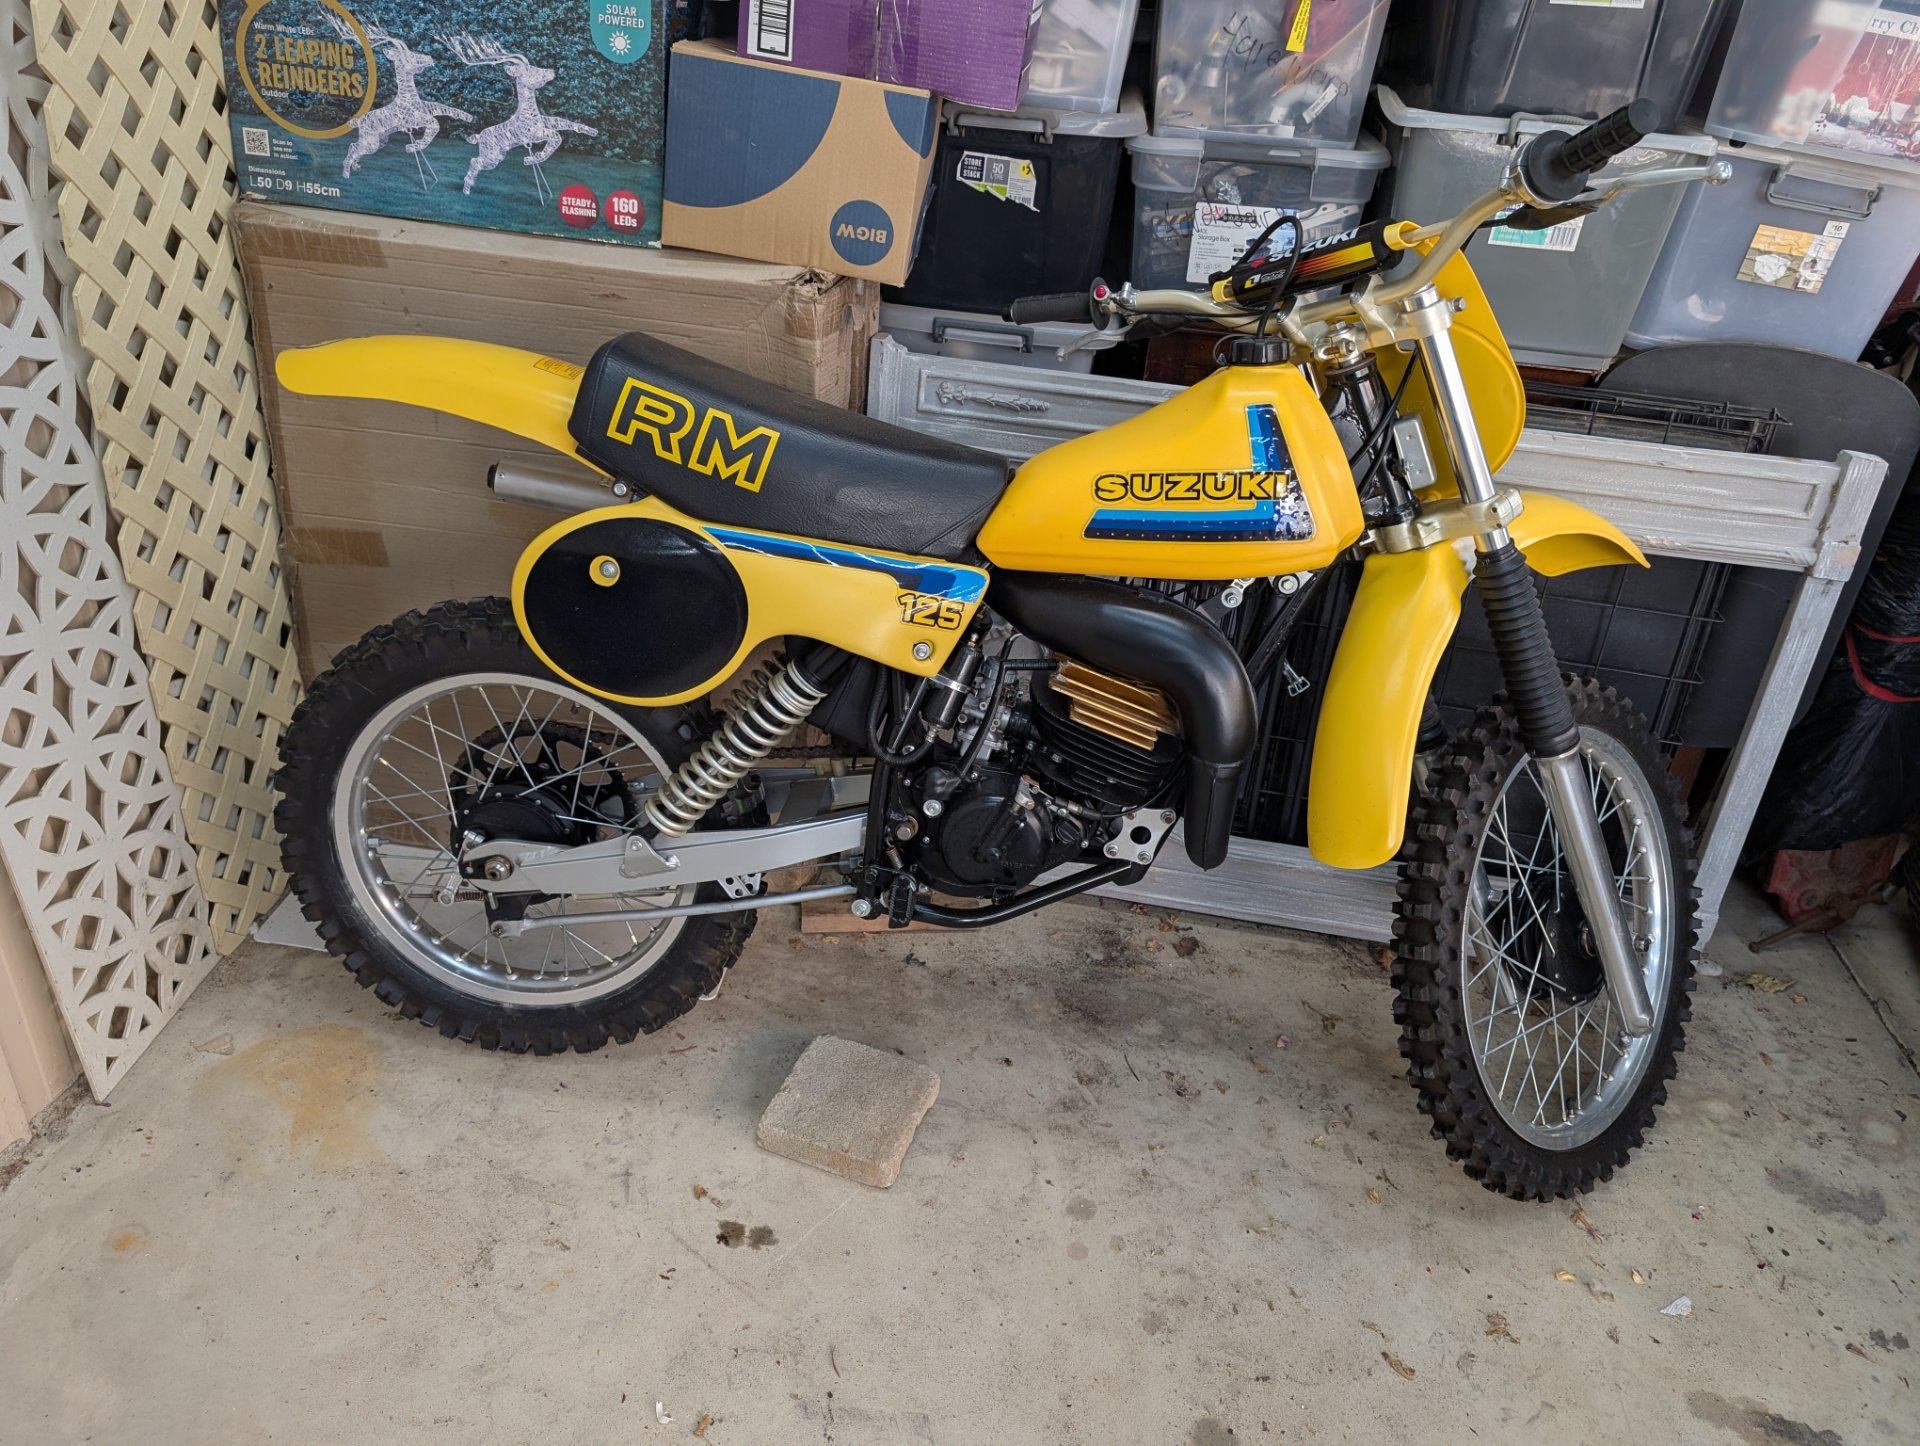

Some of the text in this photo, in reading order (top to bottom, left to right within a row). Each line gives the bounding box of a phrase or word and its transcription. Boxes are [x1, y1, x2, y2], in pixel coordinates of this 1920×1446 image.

[606, 4, 637, 17] SOLAR
[598, 14, 645, 29] POWERED
[253, 21, 315, 36] Warm White LEDs
[255, 33, 354, 70] 2 LEAPING
[257, 62, 364, 98] REINDEERS
[261, 88, 289, 99] Outdoor
[272, 138, 286, 146] Scan
[964, 157, 983, 167] STORE
[992, 162, 1005, 174] 50
[248, 165, 286, 176] Dimensions
[963, 169, 981, 179] STACK
[249, 175, 341, 198] L50 D9 H55cm
[562, 196, 592, 208] STEADY
[612, 197, 639, 215] 160
[562, 205, 597, 218] FLASHING
[614, 214, 638, 228] LEDs
[1197, 233, 1231, 242] Storage Box
[606, 376, 781, 493] RM
[1094, 469, 1292, 503] SUZUKI
[897, 592, 966, 631] 125
